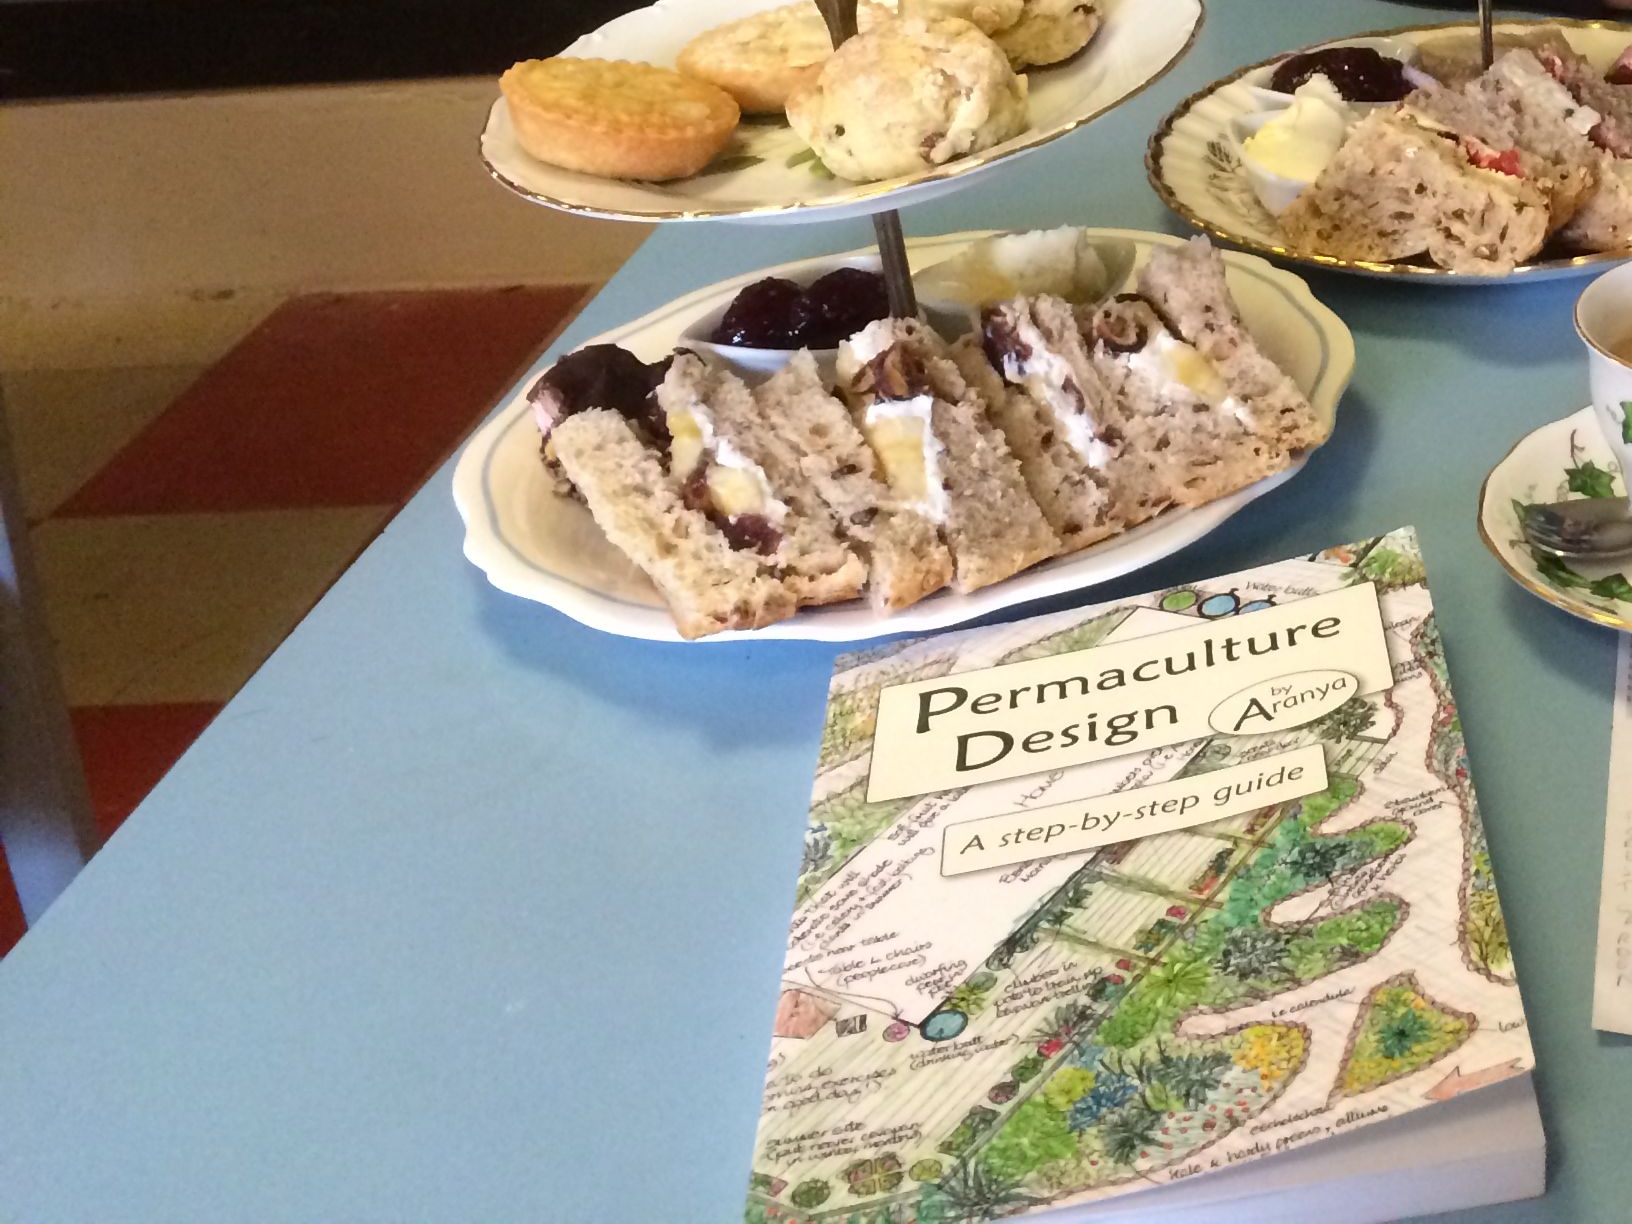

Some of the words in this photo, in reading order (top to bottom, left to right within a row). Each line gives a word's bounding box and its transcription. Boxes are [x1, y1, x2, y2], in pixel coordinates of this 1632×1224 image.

[915, 614, 1343, 735] Permaculture
[1233, 676, 1348, 732] Aranya
[1270, 683, 1293, 697] by
[955, 702, 1181, 773] Design
[959, 833, 987, 855] A
[997, 791, 1201, 850] step-by-step
[1213, 762, 1306, 808] guide
